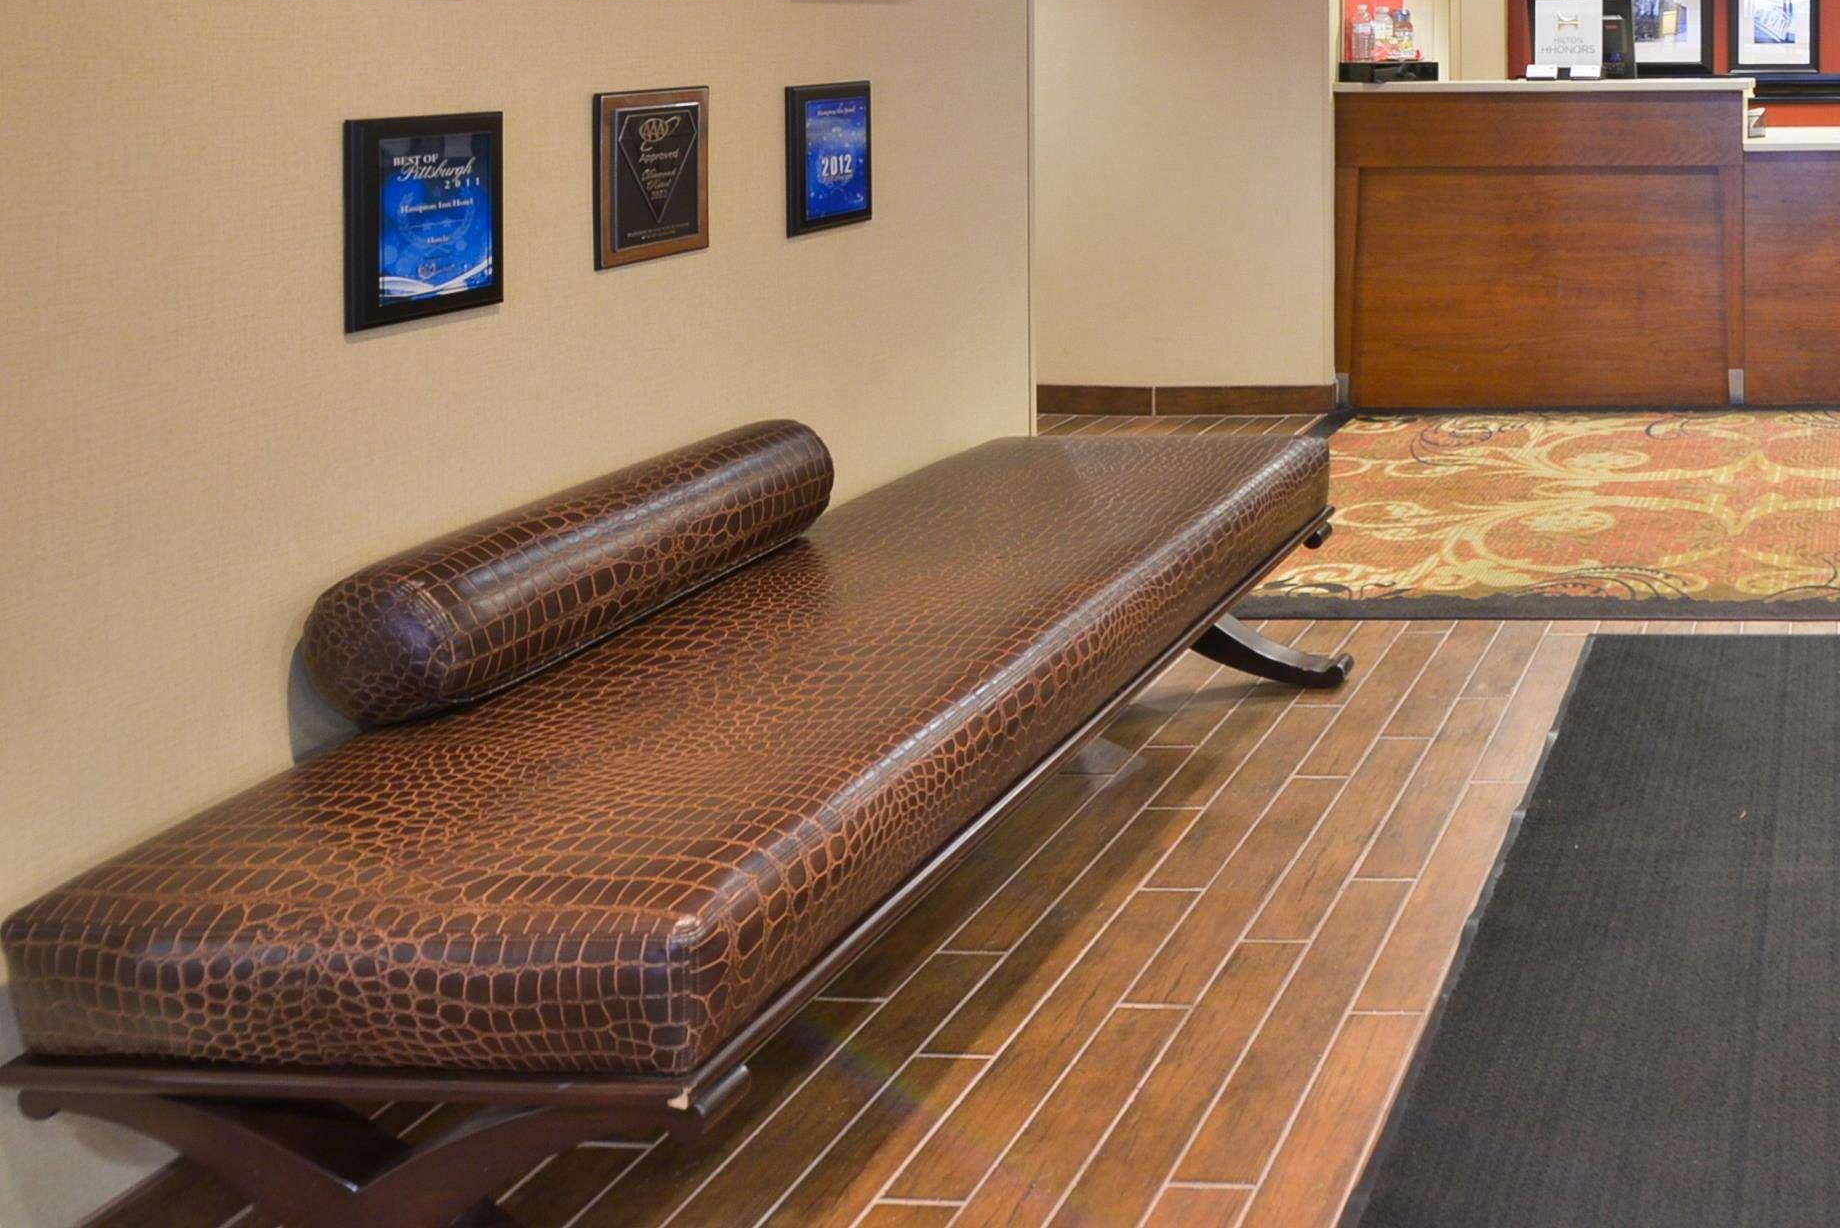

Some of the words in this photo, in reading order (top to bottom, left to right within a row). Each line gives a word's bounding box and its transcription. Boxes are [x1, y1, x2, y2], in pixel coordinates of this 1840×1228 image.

[1554, 36, 1584, 44] HILTON
[1541, 45, 1596, 54] HHONORS
[642, 119, 667, 141] AAA
[393, 155, 421, 166] BEST
[422, 153, 439, 163] OF
[639, 148, 679, 163] Approved
[397, 156, 476, 182] Pittsburgh
[821, 154, 852, 177] 2012
